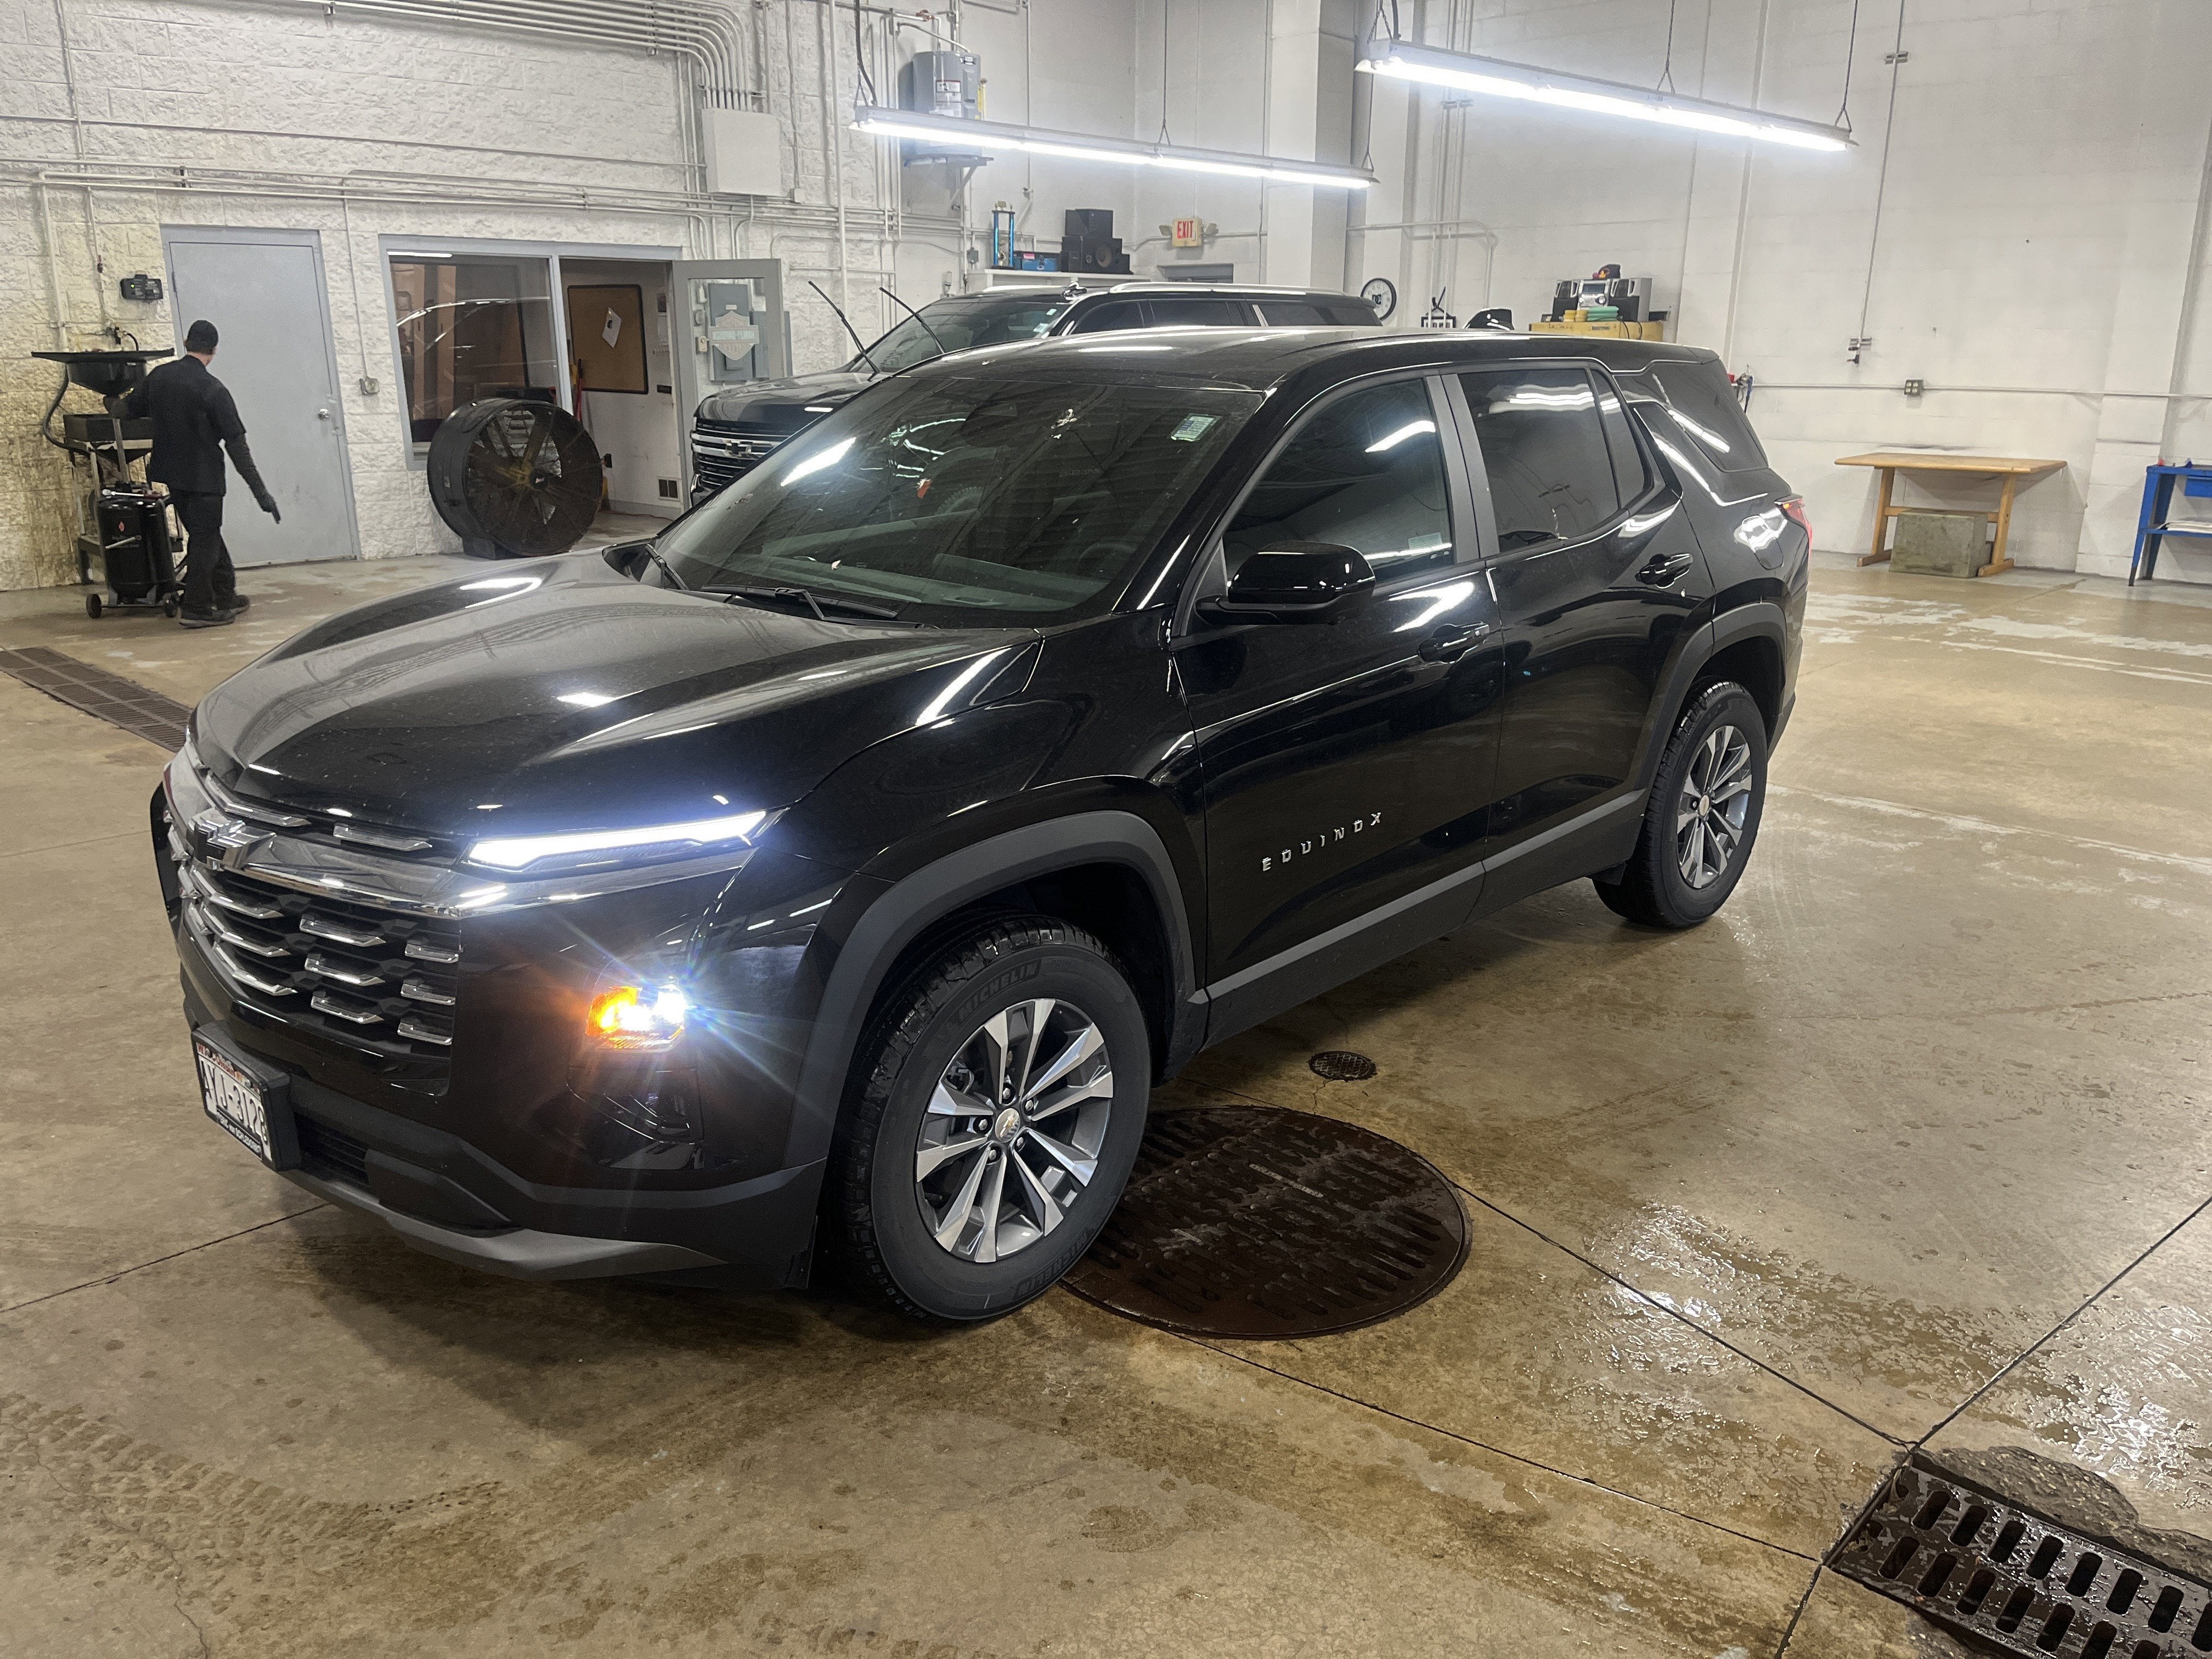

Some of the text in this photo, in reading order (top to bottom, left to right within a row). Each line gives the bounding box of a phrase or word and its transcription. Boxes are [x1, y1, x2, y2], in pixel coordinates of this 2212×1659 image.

[1177, 221, 1194, 239] EXIT
[1262, 812, 1381, 872] EQUINOX
[959, 962, 1037, 1021] MICHELIN
[201, 1060, 269, 1146] AYJ-3128
